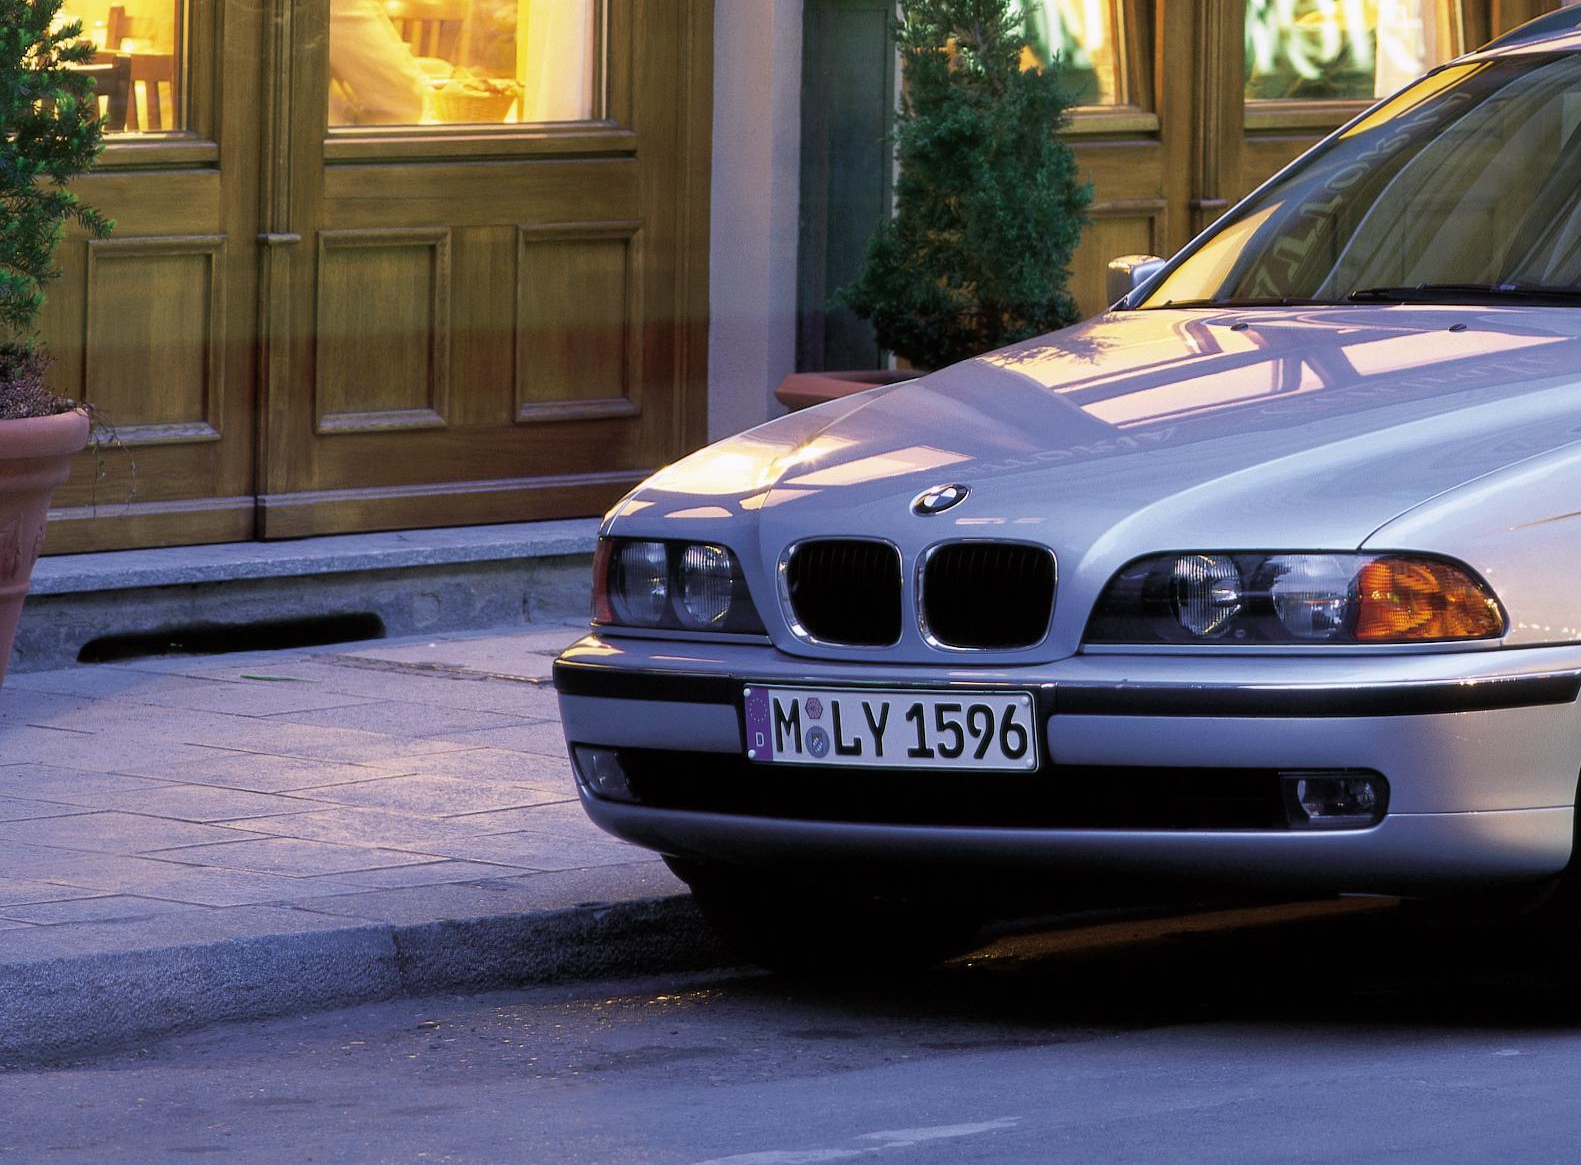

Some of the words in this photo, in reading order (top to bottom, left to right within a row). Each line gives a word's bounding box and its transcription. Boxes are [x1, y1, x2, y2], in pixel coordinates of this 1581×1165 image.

[755, 732, 764, 747] D
[773, 697, 802, 754] M
[831, 700, 890, 757] LY
[905, 701, 1028, 759] 1596
